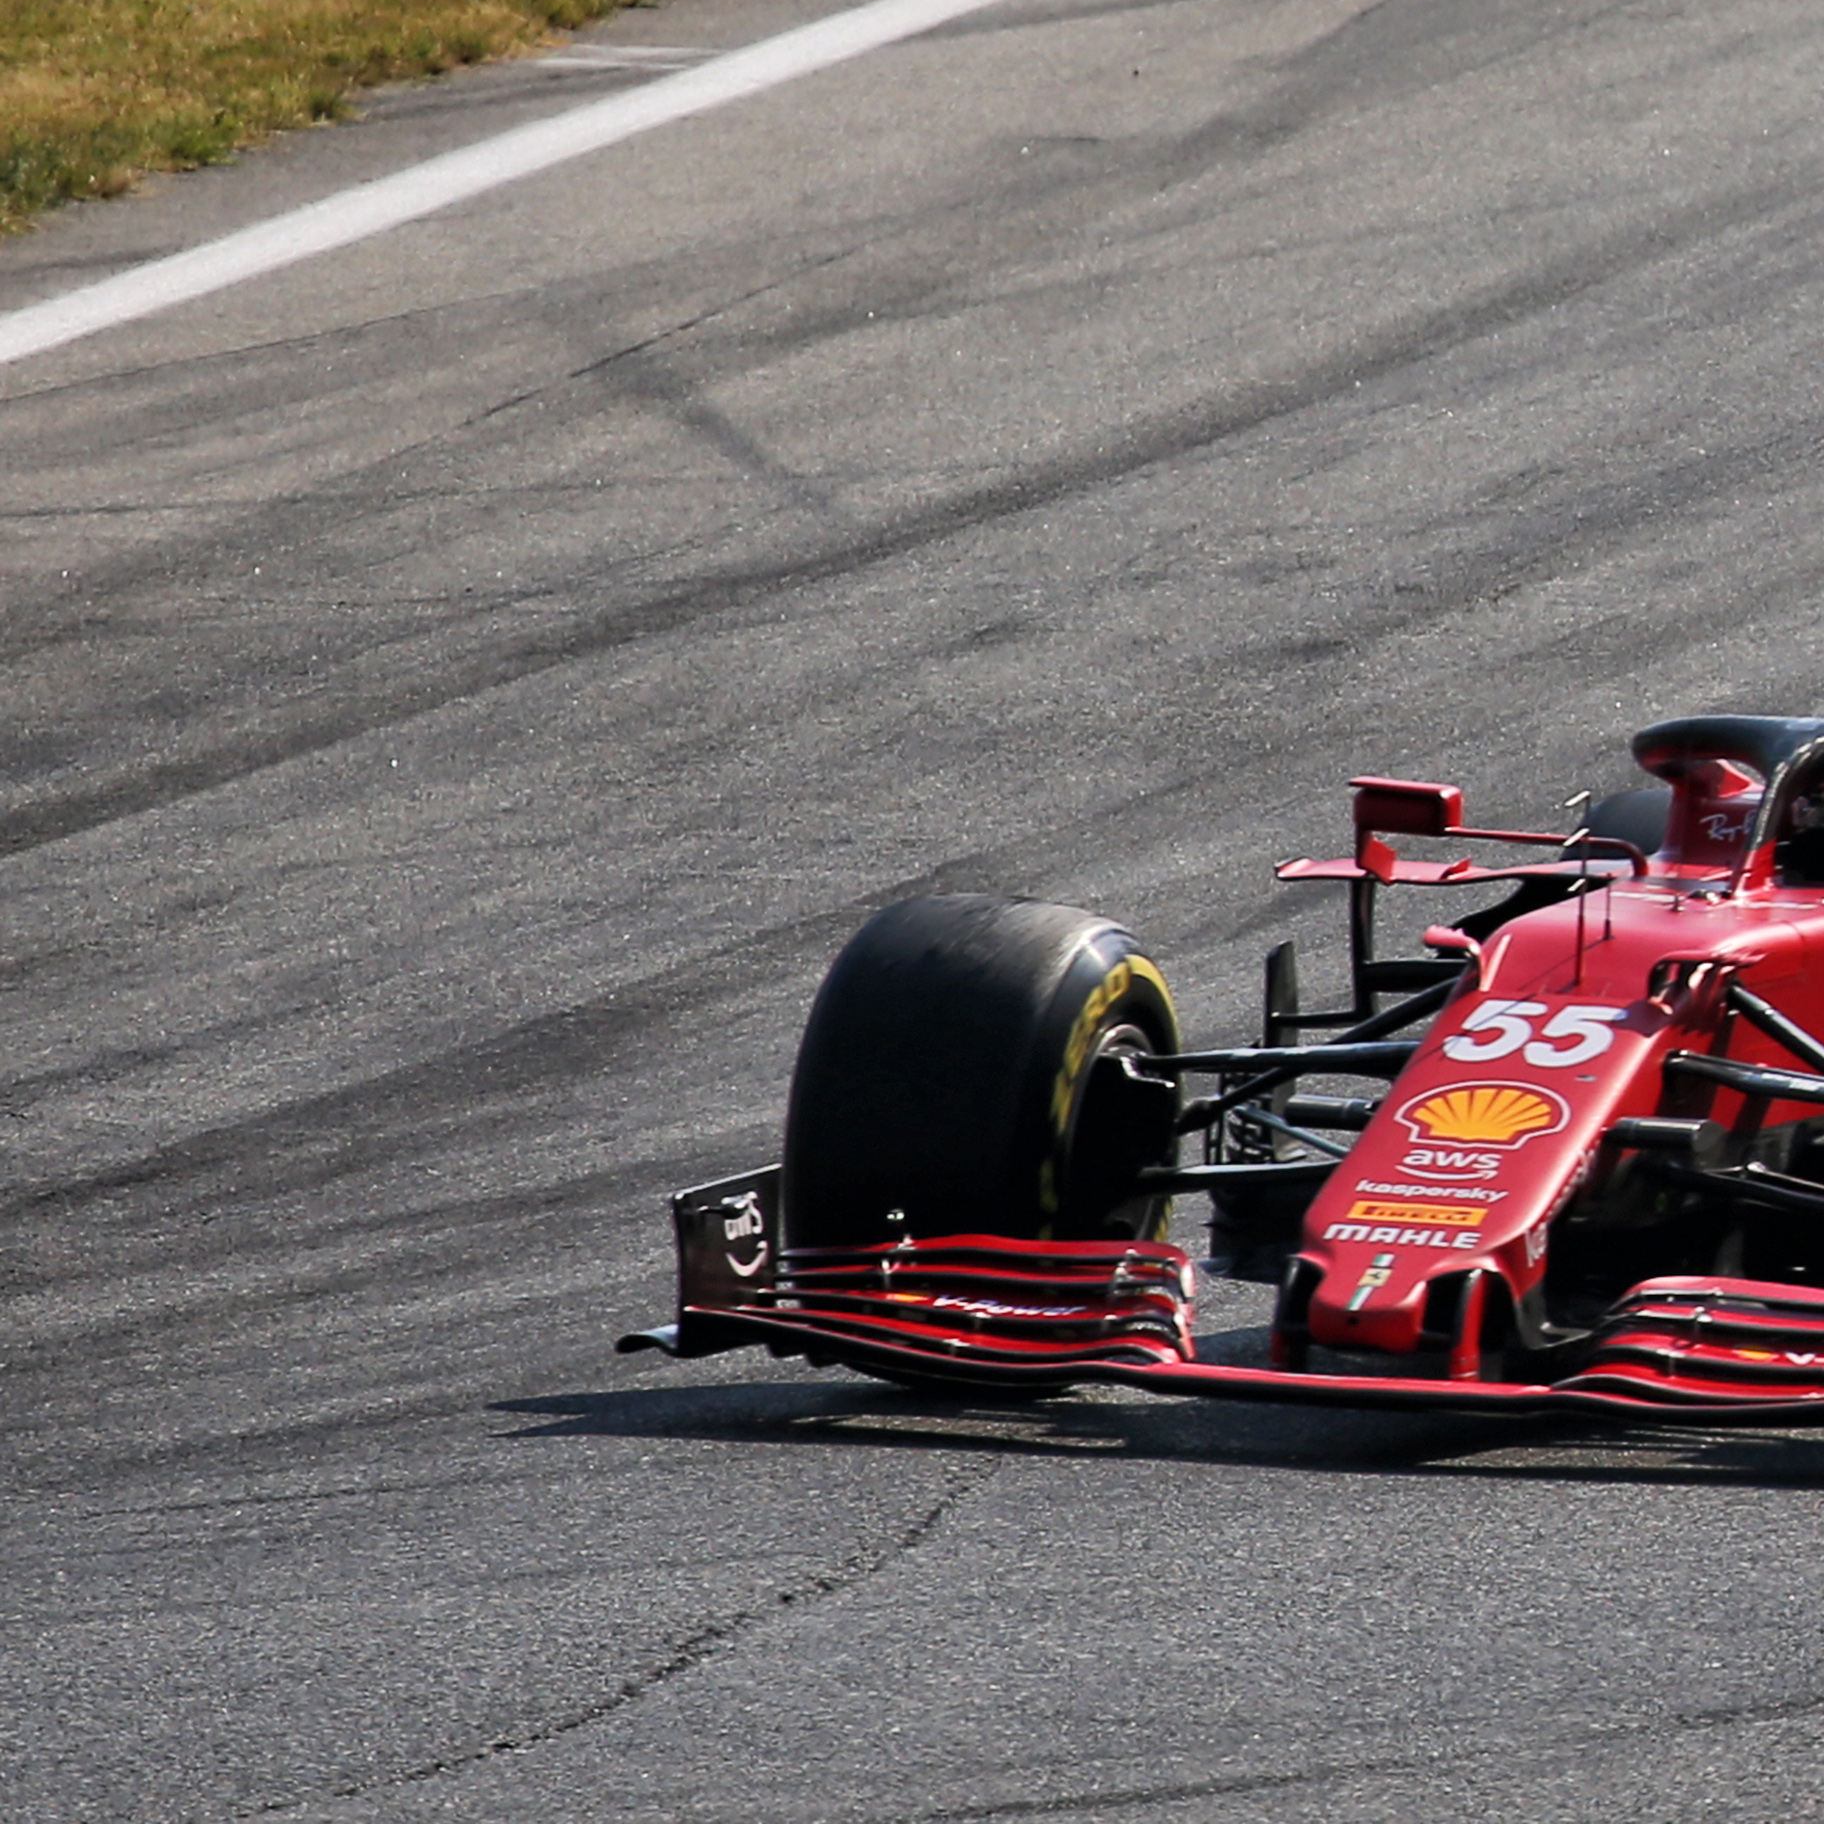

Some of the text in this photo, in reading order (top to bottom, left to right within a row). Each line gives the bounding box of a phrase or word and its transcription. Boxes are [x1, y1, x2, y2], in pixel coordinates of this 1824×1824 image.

[1442, 999, 1629, 1068] 55
[1355, 1179, 1509, 1203] kaspersky
[1323, 1223, 1482, 1250] MAHLE
